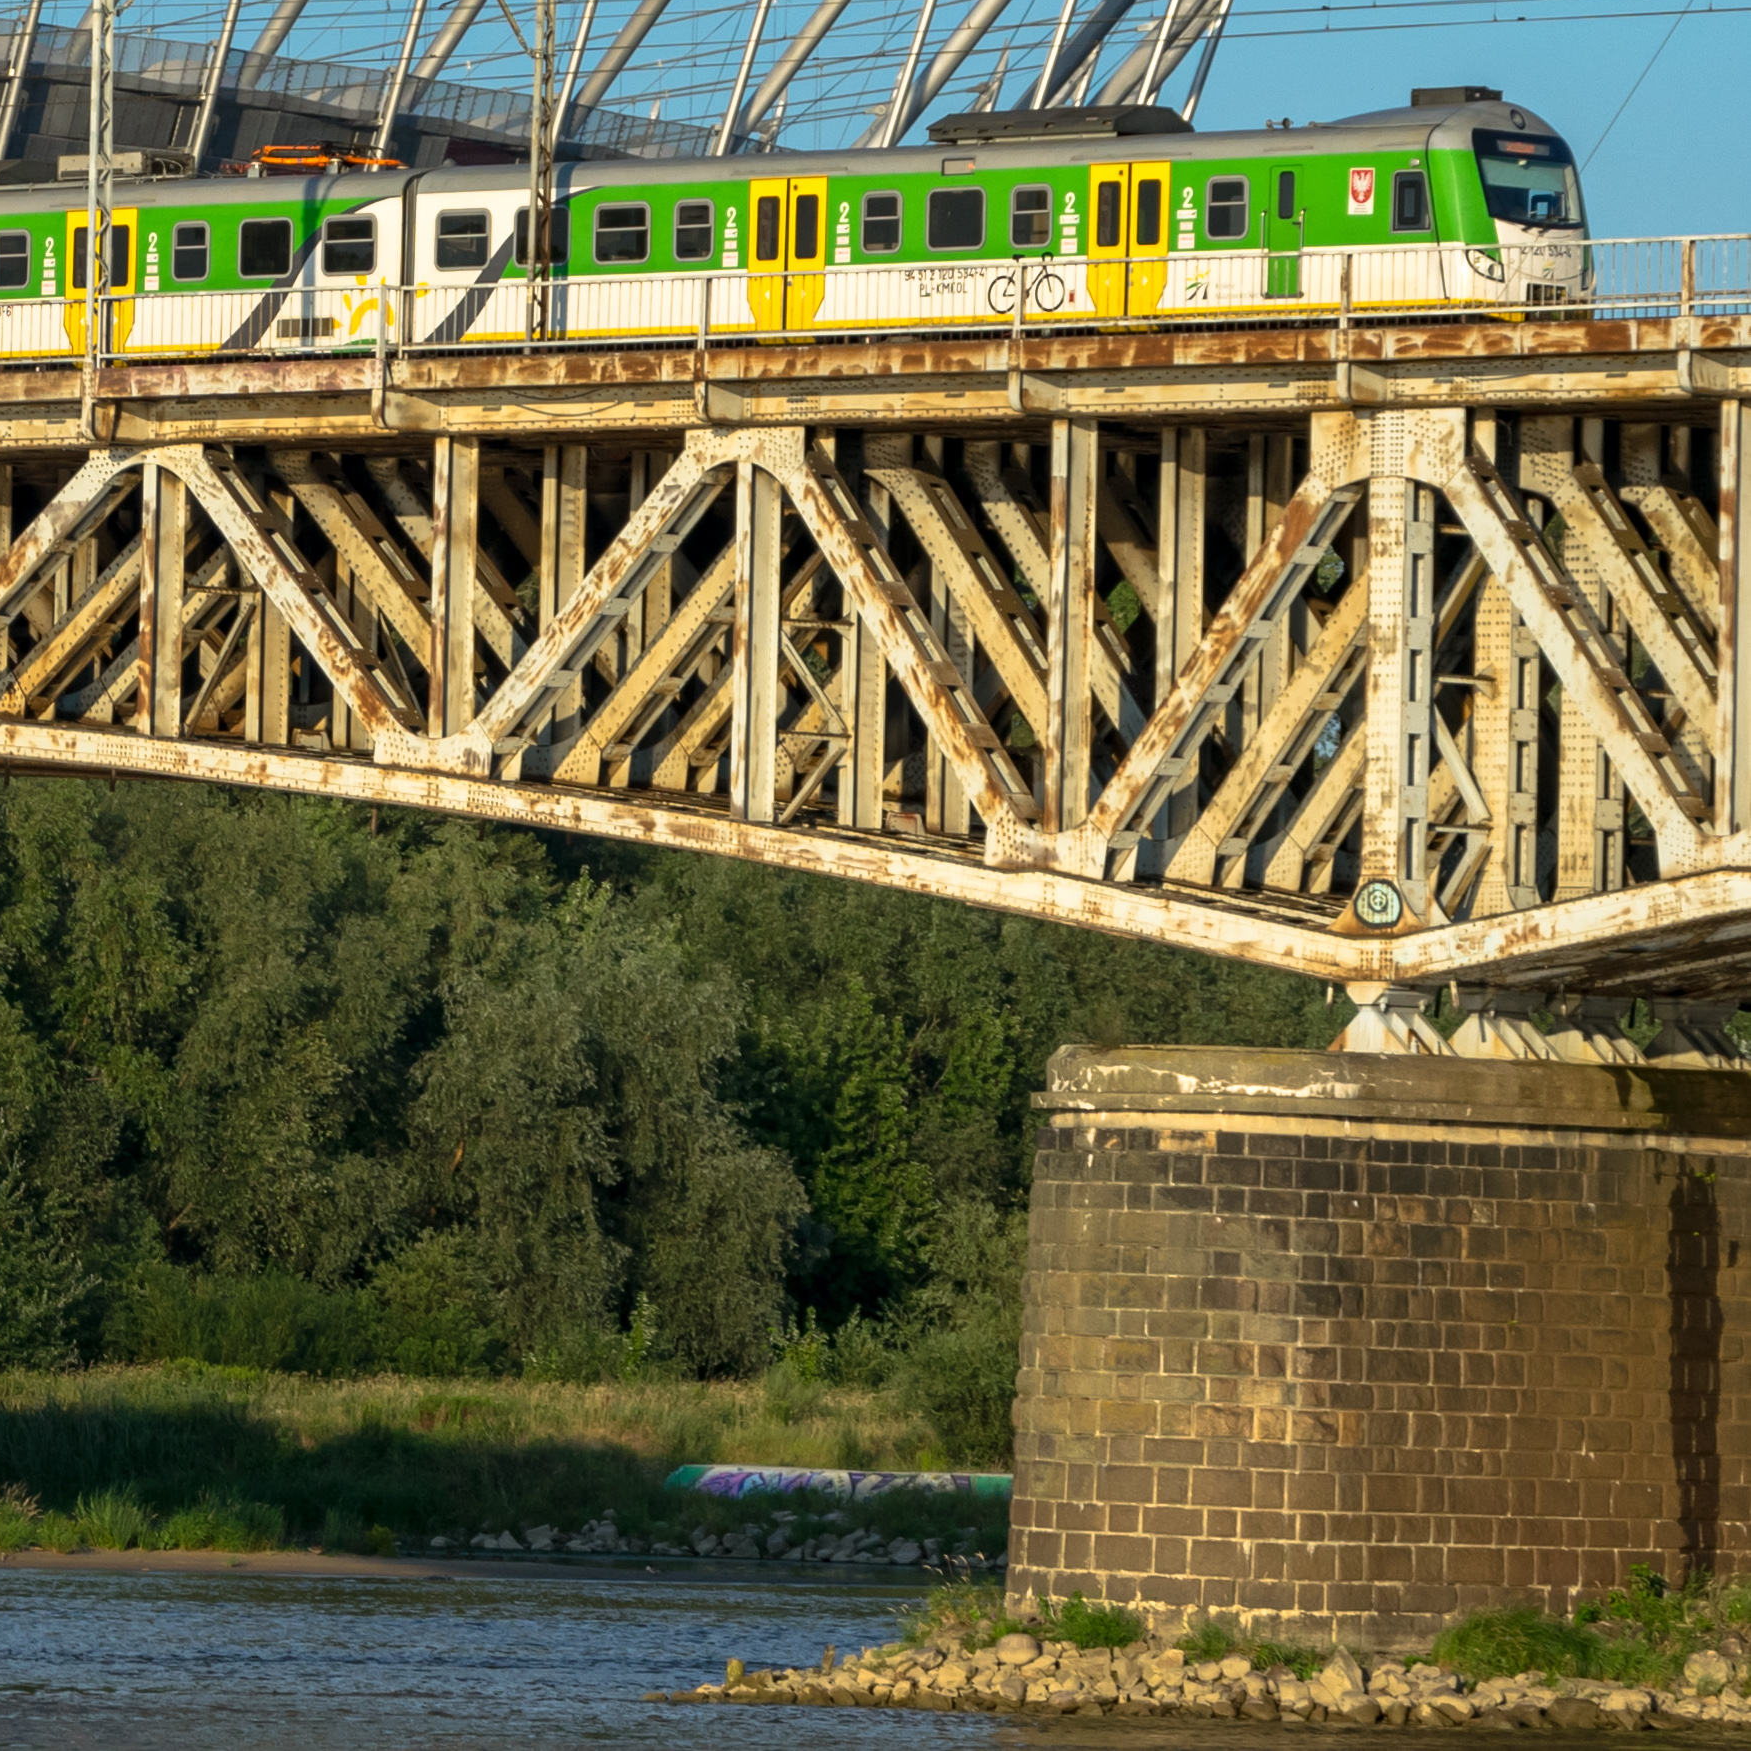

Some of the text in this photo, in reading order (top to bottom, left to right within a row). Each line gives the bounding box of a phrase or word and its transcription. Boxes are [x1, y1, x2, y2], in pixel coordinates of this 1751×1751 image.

[1065, 192, 1076, 213] 2
[1183, 187, 1194, 208] 2
[726, 207, 737, 228] 2
[839, 202, 850, 223] 2
[44, 237, 54, 257] 2
[148, 232, 158, 252] 2
